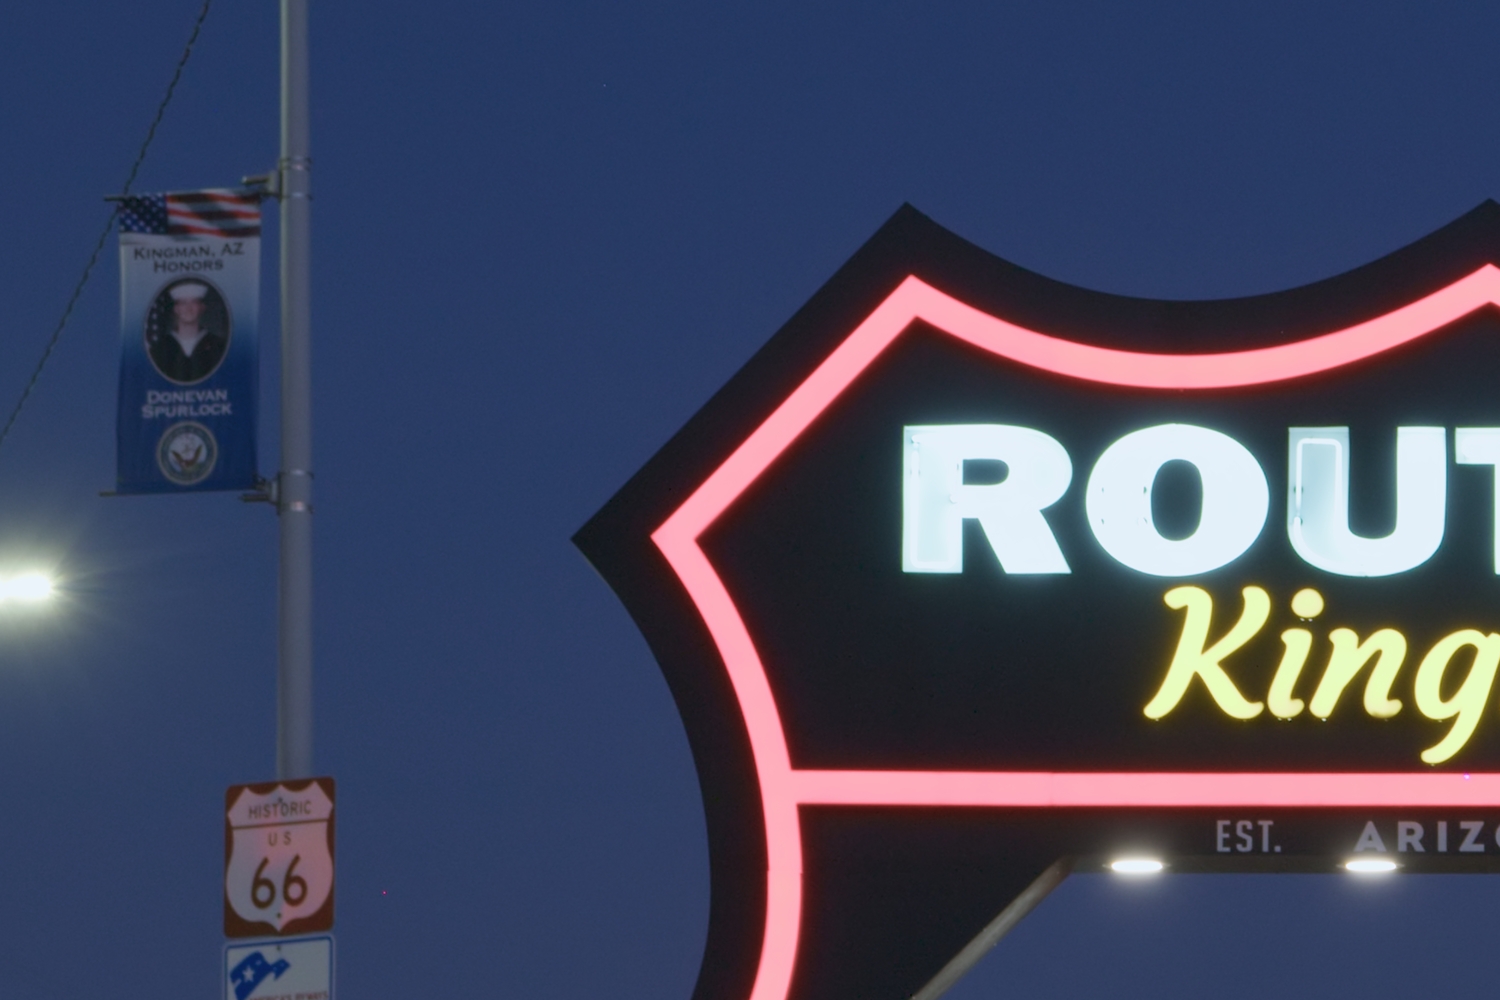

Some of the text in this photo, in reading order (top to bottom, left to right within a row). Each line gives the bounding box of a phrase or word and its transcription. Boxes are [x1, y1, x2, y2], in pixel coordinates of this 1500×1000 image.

[134, 242, 245, 261] KINGMAN, AZ
[153, 258, 224, 273] HONORS
[146, 389, 228, 405] DONEVAN
[142, 402, 232, 418] SPURLOCK
[248, 800, 312, 820] HISTORIC
[1216, 819, 1282, 854] EST.
[251, 854, 308, 910] 66
